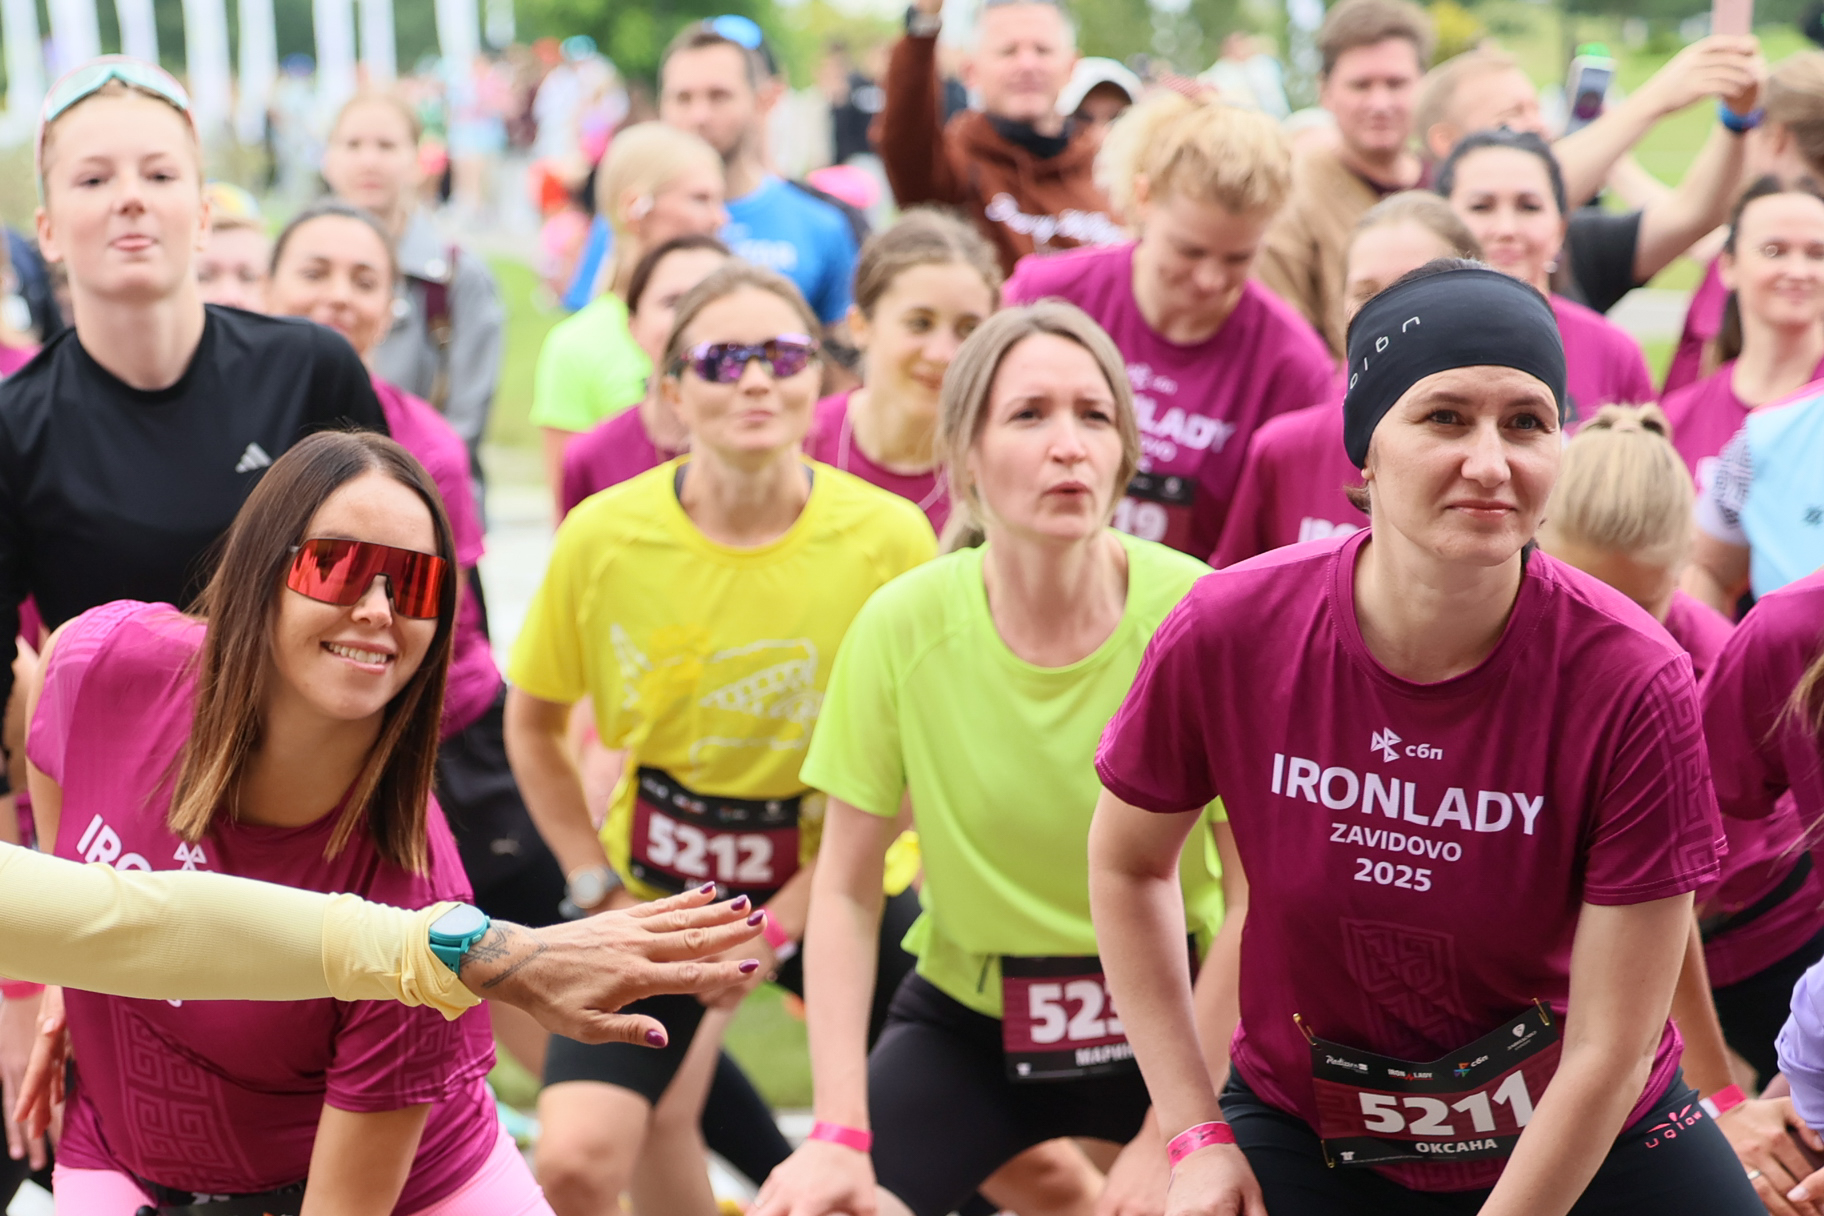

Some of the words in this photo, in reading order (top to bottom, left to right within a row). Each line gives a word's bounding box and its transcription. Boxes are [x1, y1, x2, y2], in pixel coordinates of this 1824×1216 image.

[1405, 743, 1443, 760] сбп
[1271, 752, 1544, 836] IRONLADY
[646, 811, 774, 884] 5212
[1329, 822, 1463, 862] ZAVIDOVO
[1353, 857, 1433, 892] 2025
[1358, 1070, 1534, 1136] 5211
[1415, 1138, 1498, 1154] ОКСАНА
